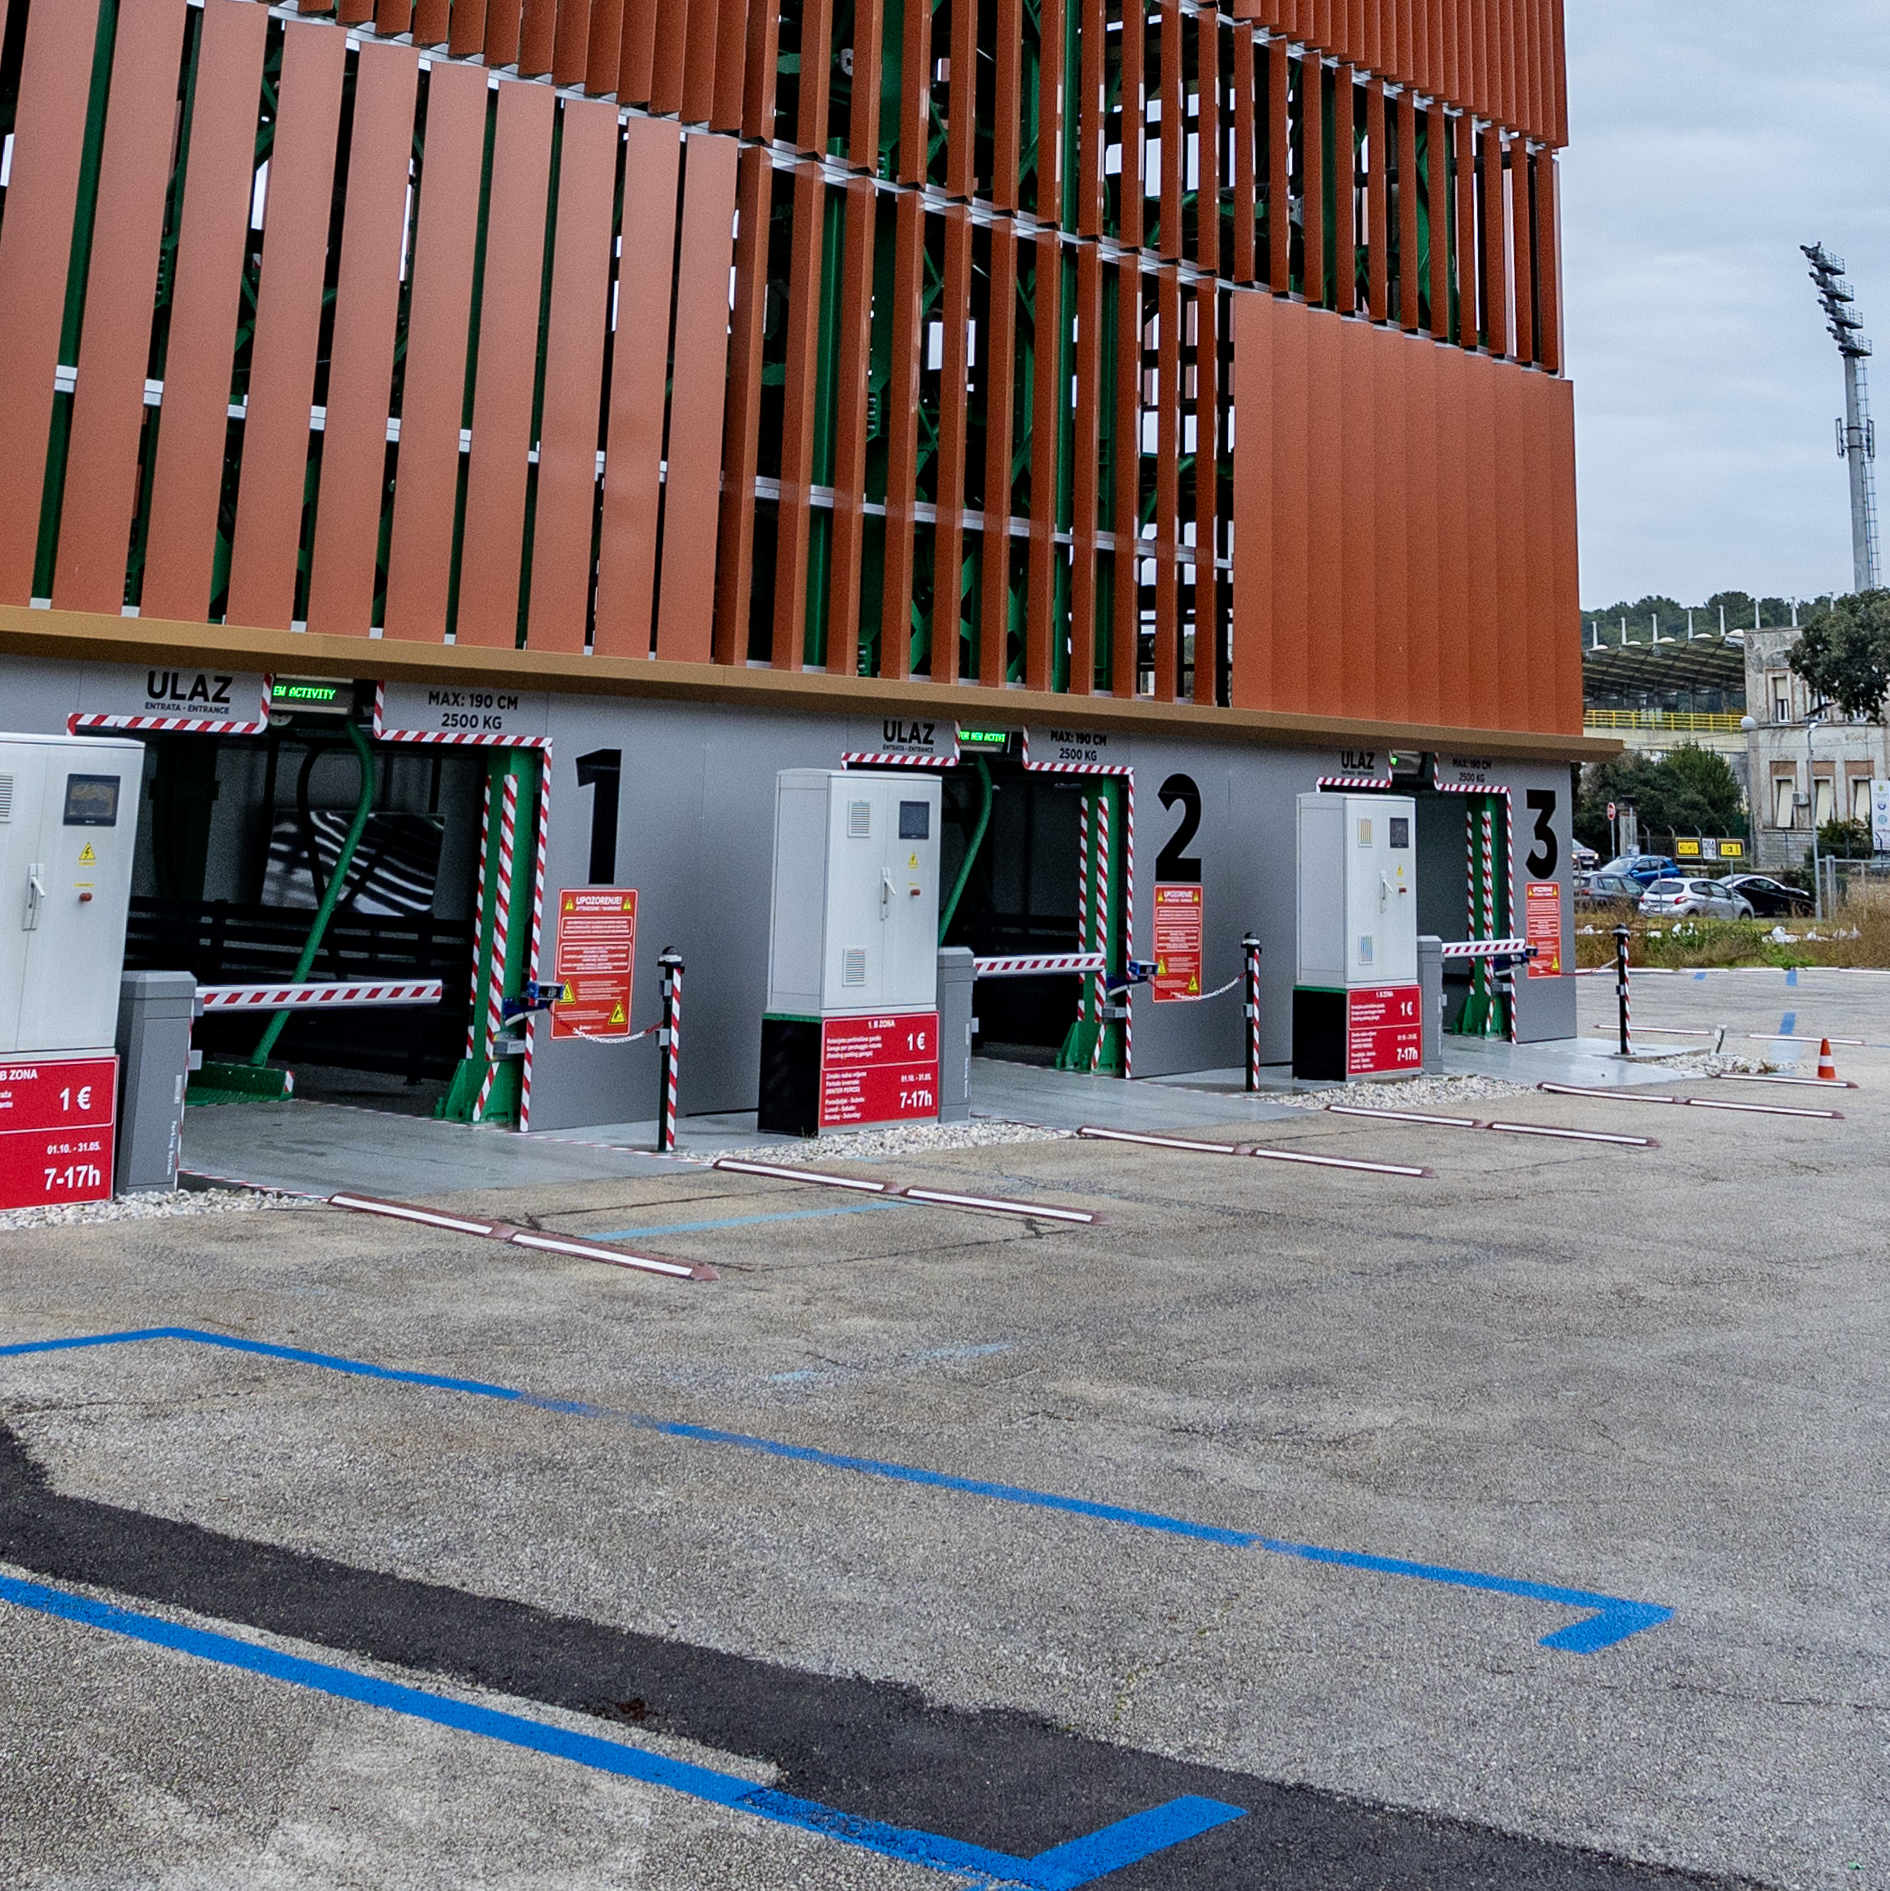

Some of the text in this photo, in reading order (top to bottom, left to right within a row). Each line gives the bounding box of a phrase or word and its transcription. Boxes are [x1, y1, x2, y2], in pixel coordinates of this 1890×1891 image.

[147, 670, 233, 704] ULAZ
[288, 686, 336, 700] ACTIVITY
[145, 701, 181, 712] ENTRATA
[187, 704, 230, 715] ENTRANCE
[428, 691, 518, 710] MAX: 190 CM
[441, 713, 502, 730] 2500 KG
[883, 720, 935, 745] ULAZ
[1050, 729, 1107, 746] MAX: 190 CM
[1059, 747, 1097, 762] 2500 KG
[1341, 751, 1375, 770] ULAZ
[575, 748, 622, 885] 1
[1155, 773, 1202, 882] 2
[1525, 789, 1558, 880] 3
[907, 1032, 926, 1051] 1 €
[0, 1070, 8, 1081] B
[9, 1069, 38, 1081] ZONA
[60, 1085, 92, 1112] 1 €
[899, 1090, 933, 1109] 7-17h
[47, 1143, 71, 1156] 01.10.
[43, 1164, 102, 1191] 7-17h
